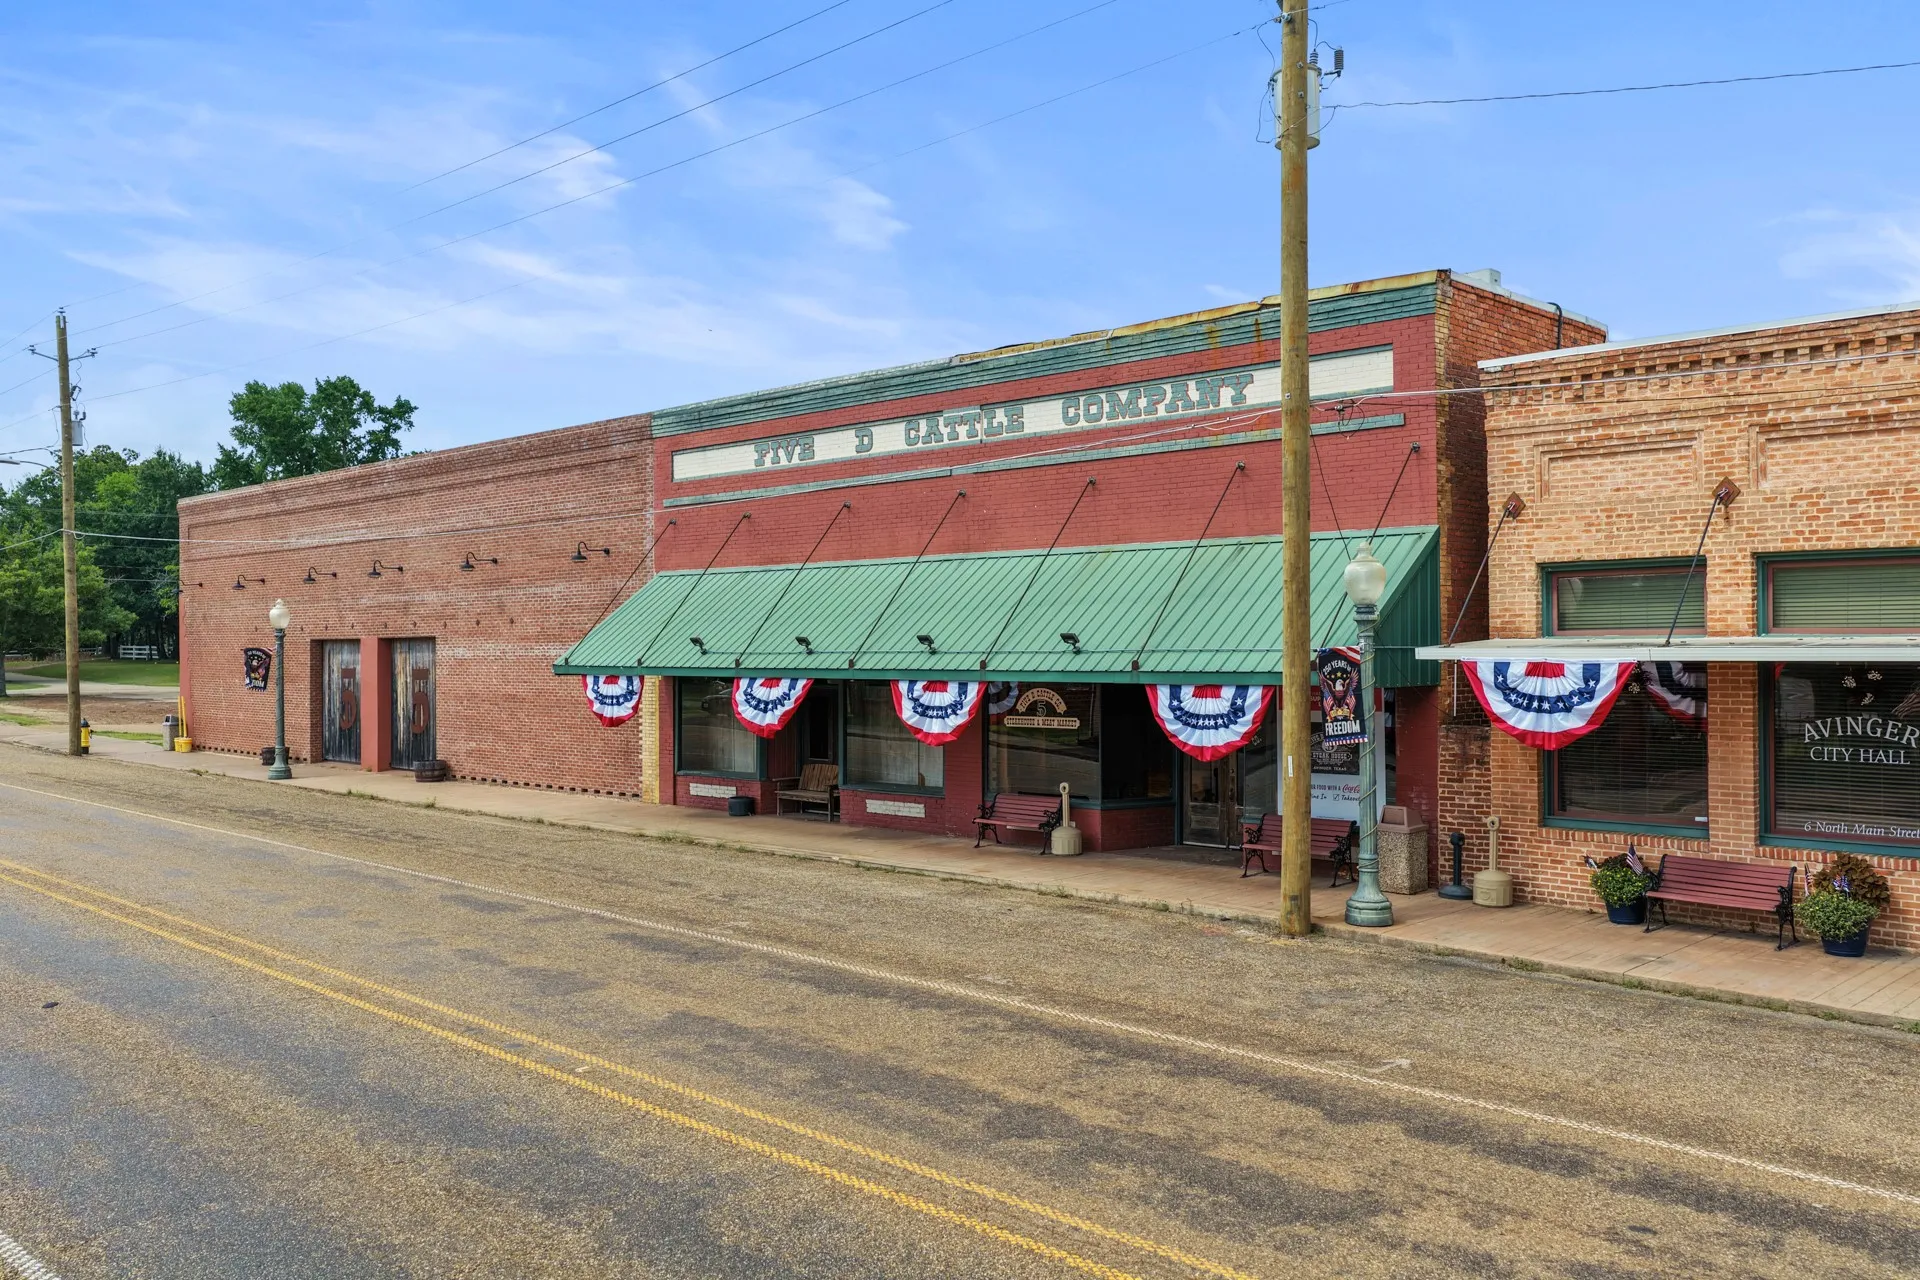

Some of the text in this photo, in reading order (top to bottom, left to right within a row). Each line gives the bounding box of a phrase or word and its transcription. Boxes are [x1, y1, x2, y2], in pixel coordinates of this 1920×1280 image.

[754, 372, 1254, 467] FIVE D CATTLE COMPANY
[1322, 663, 1332, 676] 250
[1331, 659, 1348, 669] YEARS
[1020, 695, 1031, 709] FIVE
[1036, 689, 1055, 701] CATTLE
[1006, 717, 1035, 726] STEAKHOUSE
[1041, 718, 1055, 727] MEAT
[1057, 718, 1077, 728] MARKET
[1325, 719, 1361, 736] FREEDOM
[1804, 716, 1920, 749] AVINGER
[1810, 746, 1911, 765] CITY HALL
[1804, 821, 1920, 839] 6 North Main Street
